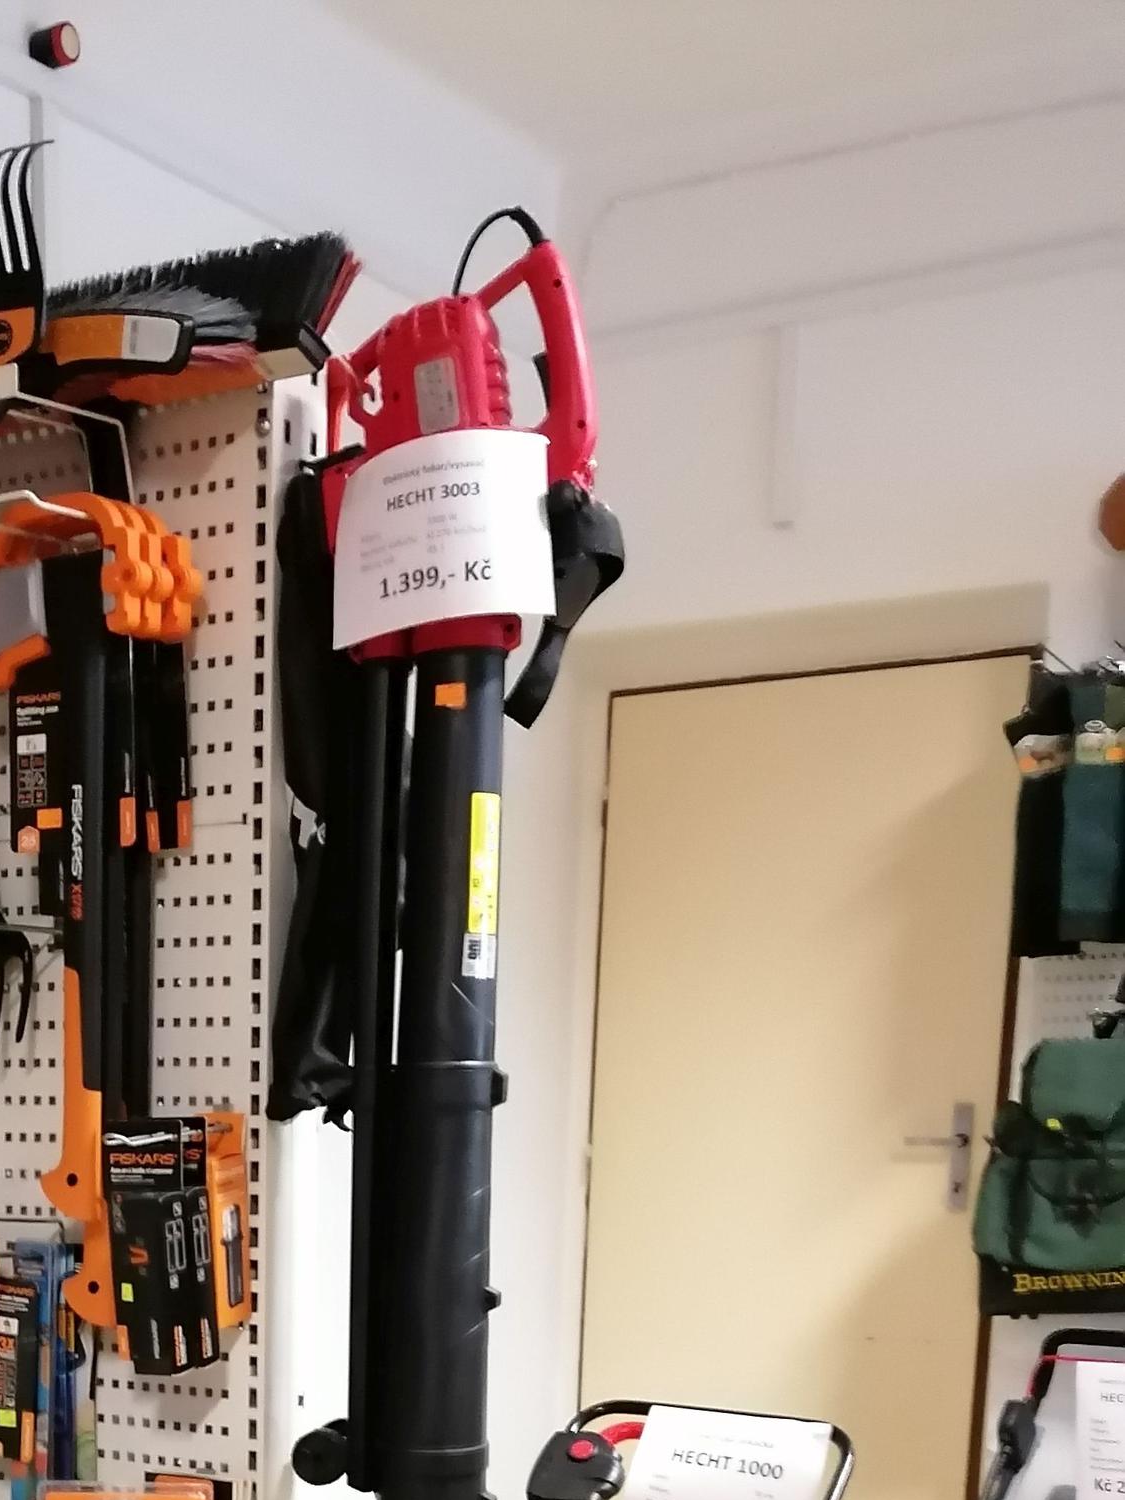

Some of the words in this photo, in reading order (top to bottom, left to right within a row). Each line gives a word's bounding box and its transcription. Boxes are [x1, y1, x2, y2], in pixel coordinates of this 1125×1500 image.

[386, 486, 436, 512] HECHT
[440, 482, 480, 499] 3003
[379, 566, 455, 600] 1.399,-
[464, 558, 492, 582] Kč
[71, 784, 83, 880] FISKARS
[109, 1152, 175, 1165] FISKARS
[671, 1448, 732, 1470] HECHT
[737, 1458, 784, 1480] 1000
[1094, 1478, 1112, 1492] Kč
